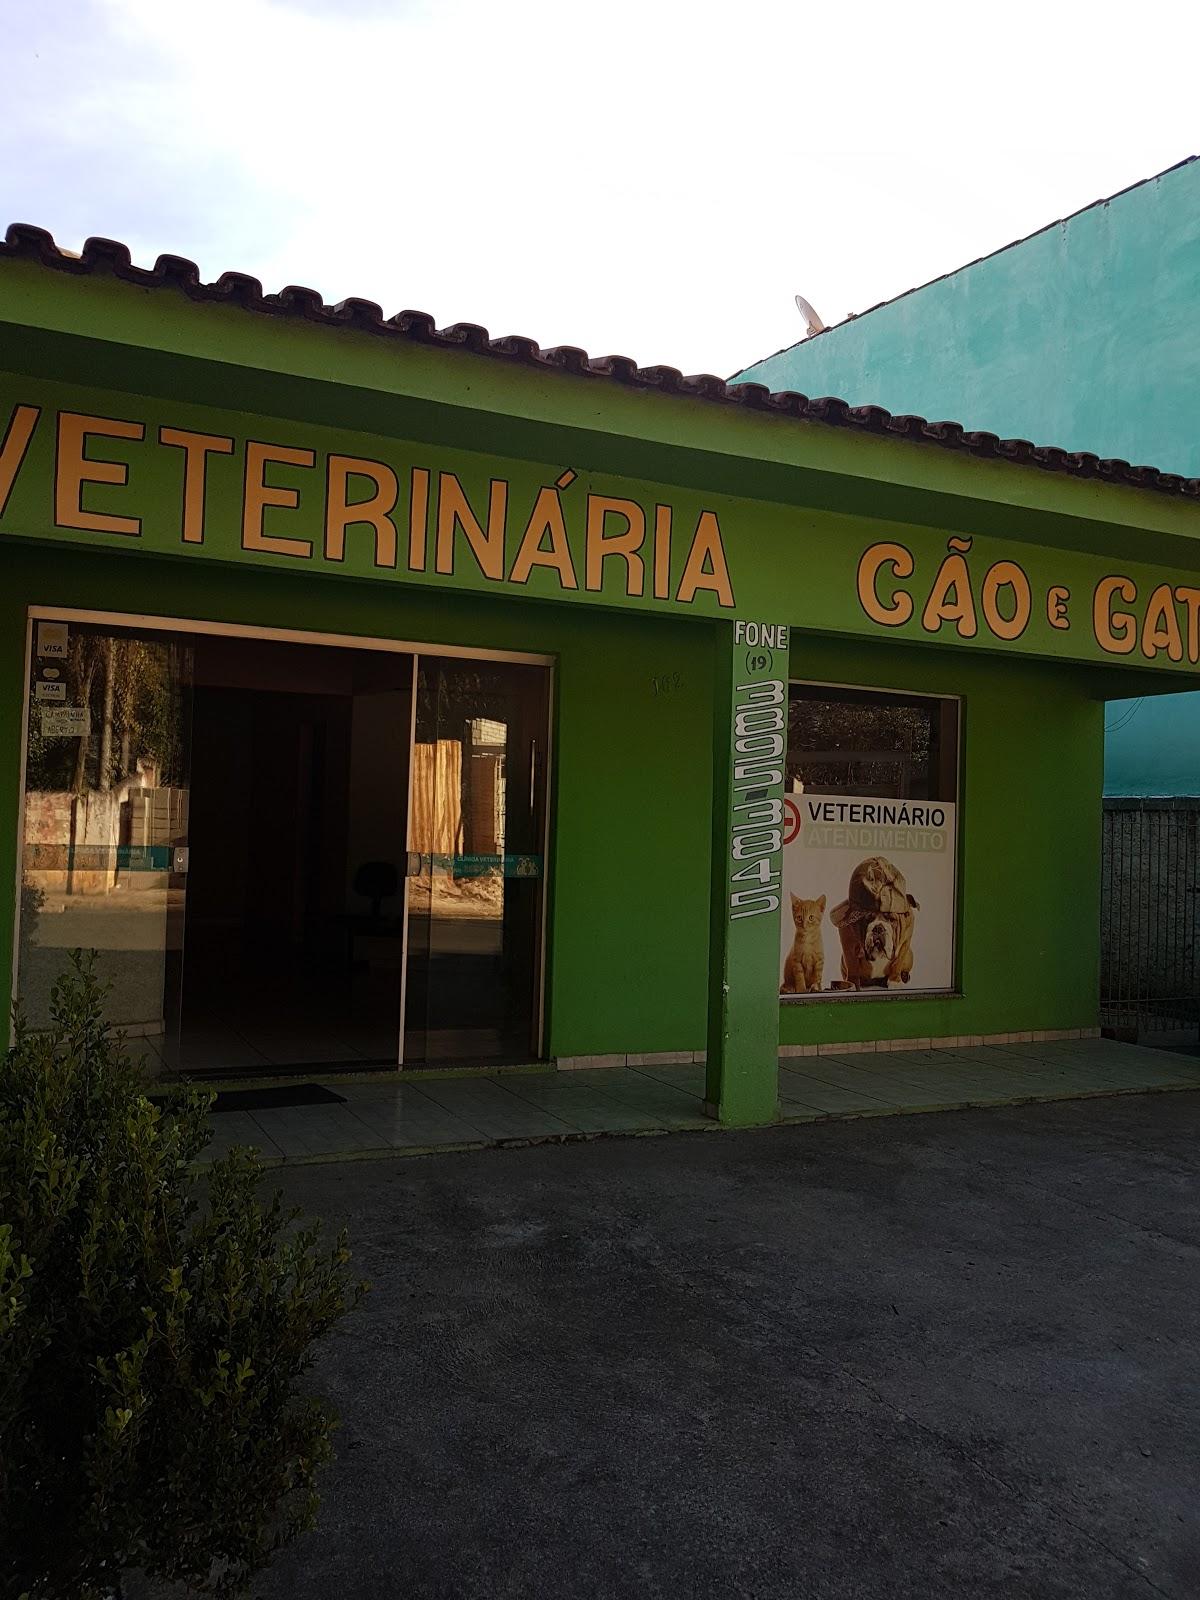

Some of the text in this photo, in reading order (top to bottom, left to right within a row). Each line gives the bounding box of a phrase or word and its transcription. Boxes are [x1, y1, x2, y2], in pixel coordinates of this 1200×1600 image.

[856, 536, 1032, 641] CÃO
[1093, 574, 1200, 665] GAT
[735, 620, 788, 650] FONE
[43, 644, 63, 653] VISA
[746, 650, 773, 675] (19)
[808, 802, 945, 827] VETERINÁRIO
[808, 827, 945, 849] ATENDIMENTO
